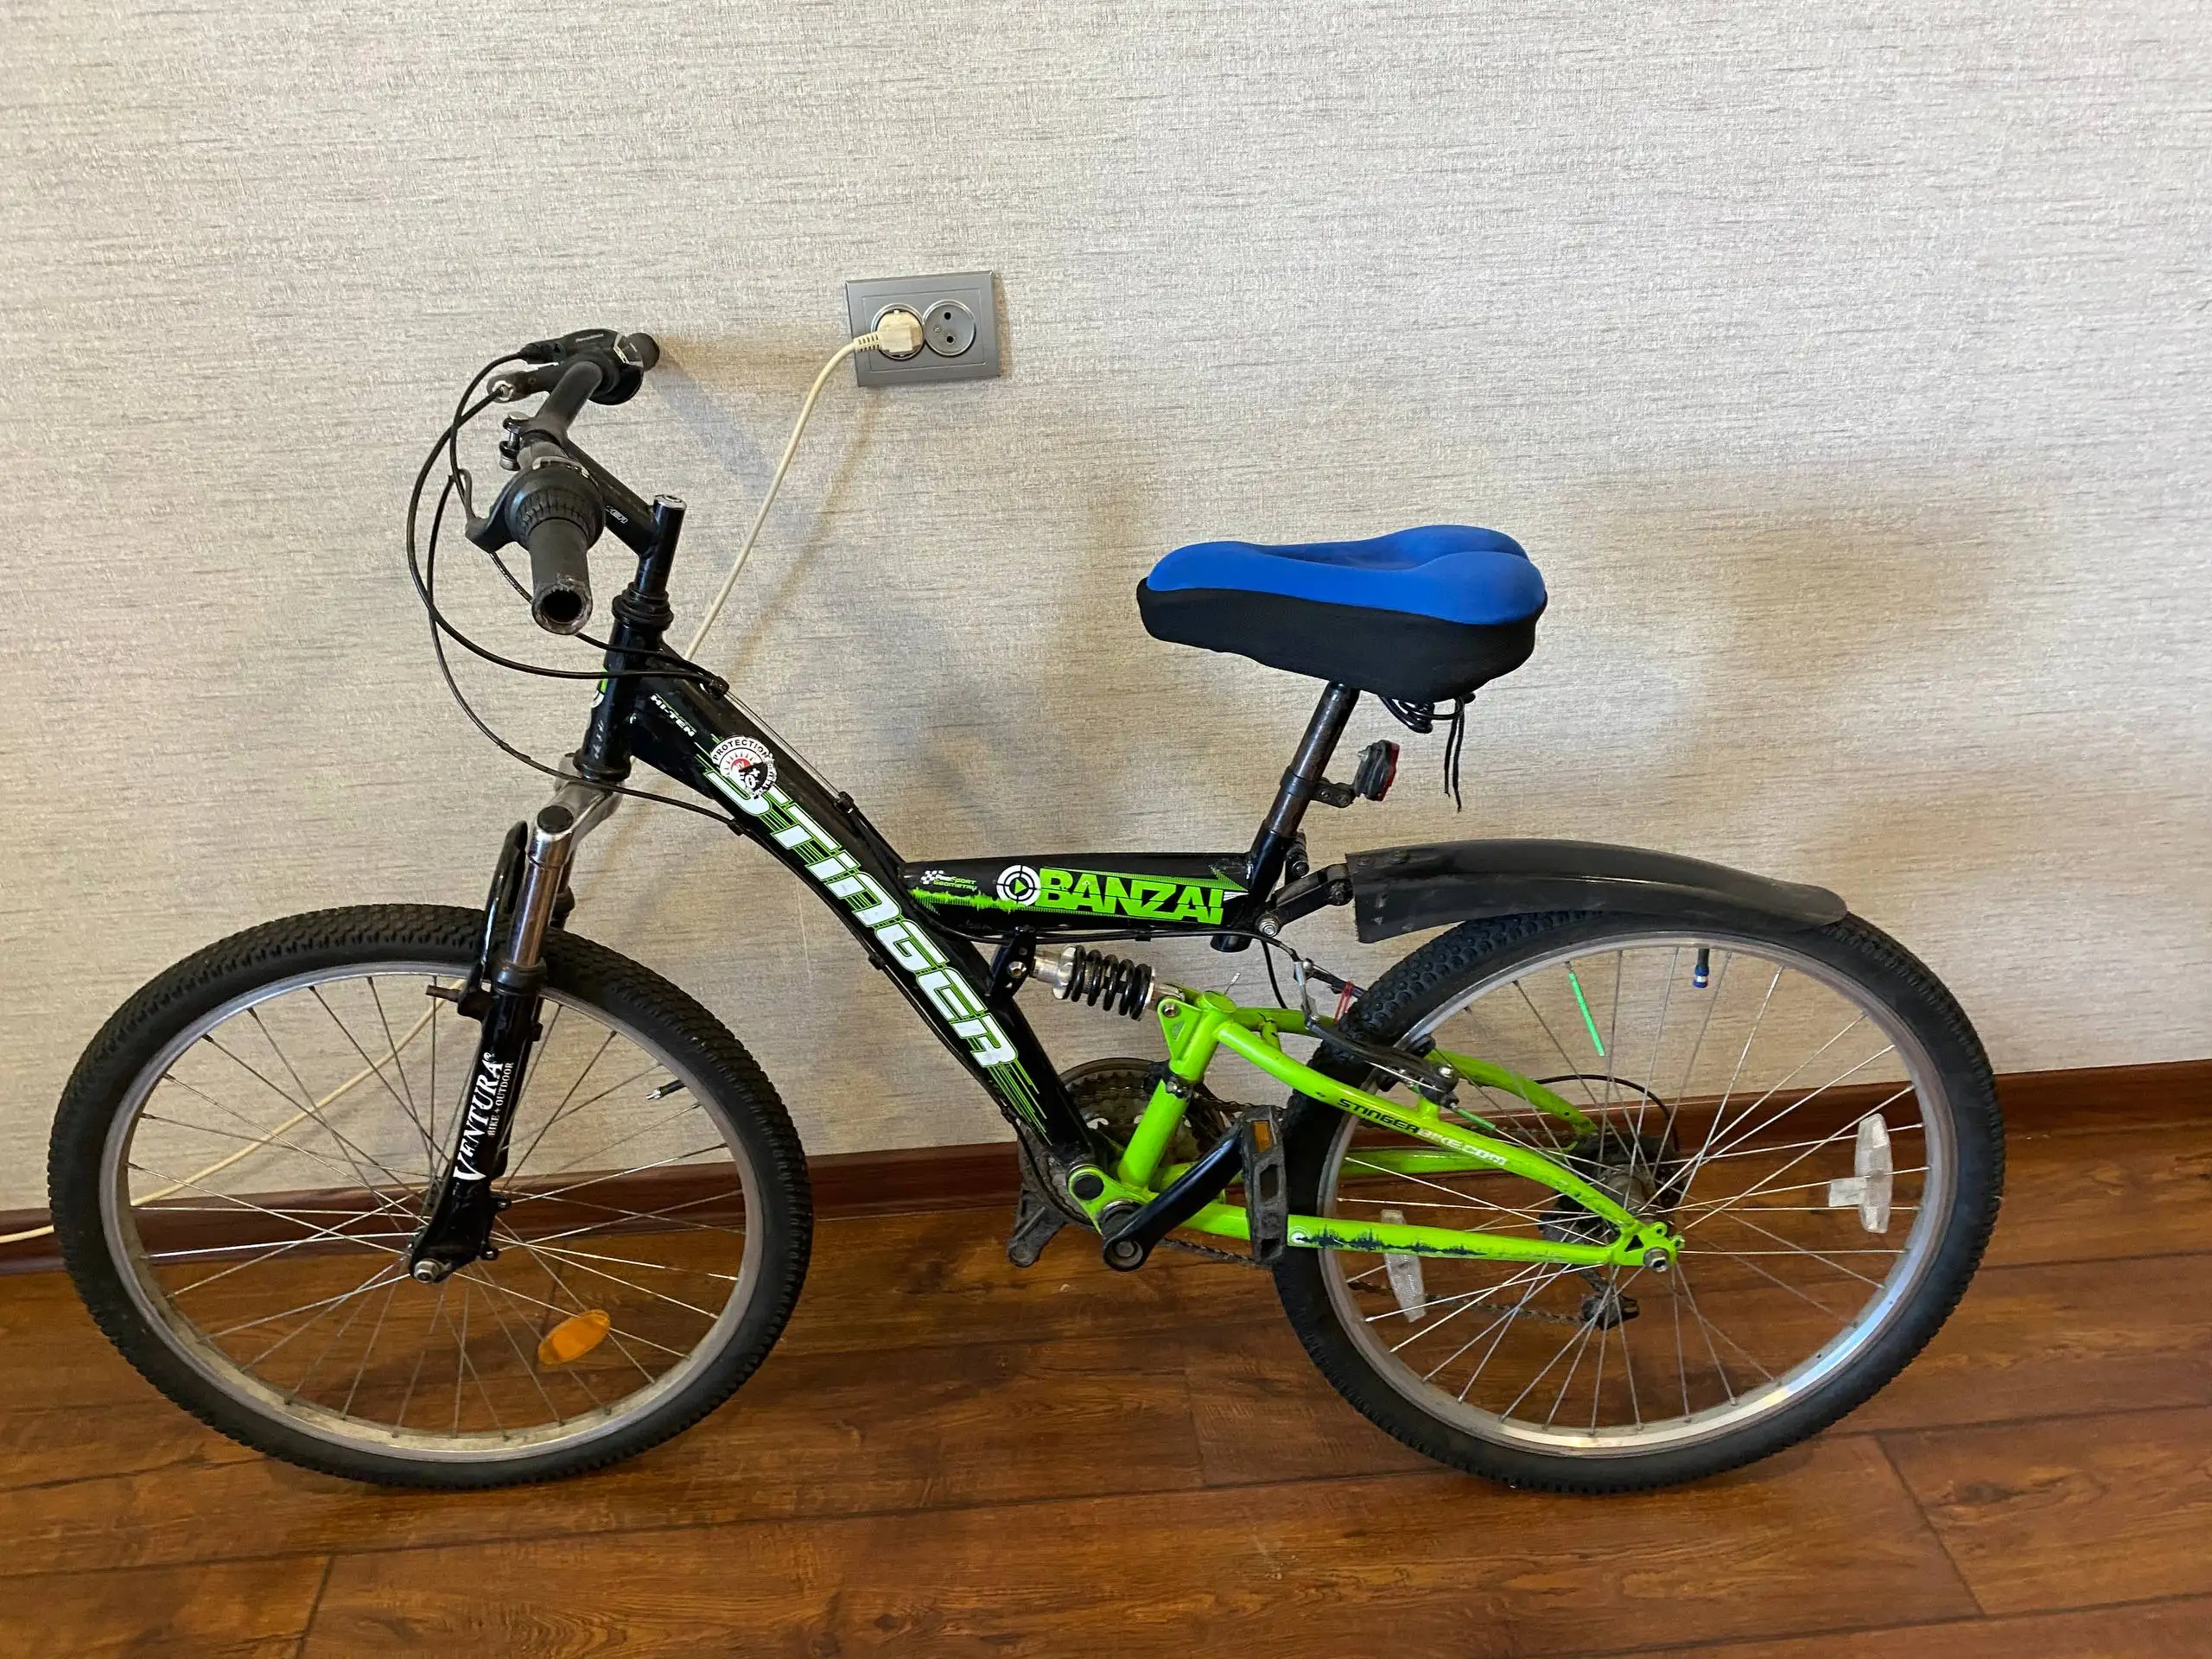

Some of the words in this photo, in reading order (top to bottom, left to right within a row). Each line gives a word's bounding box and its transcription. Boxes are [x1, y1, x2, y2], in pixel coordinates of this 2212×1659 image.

[651, 695, 696, 736] HI-TEN
[712, 739, 771, 760] PROTECTION
[1035, 868, 1224, 925] BANZAI
[487, 1115, 500, 1137] BIKE
[495, 1062, 515, 1107] OUTDOOR
